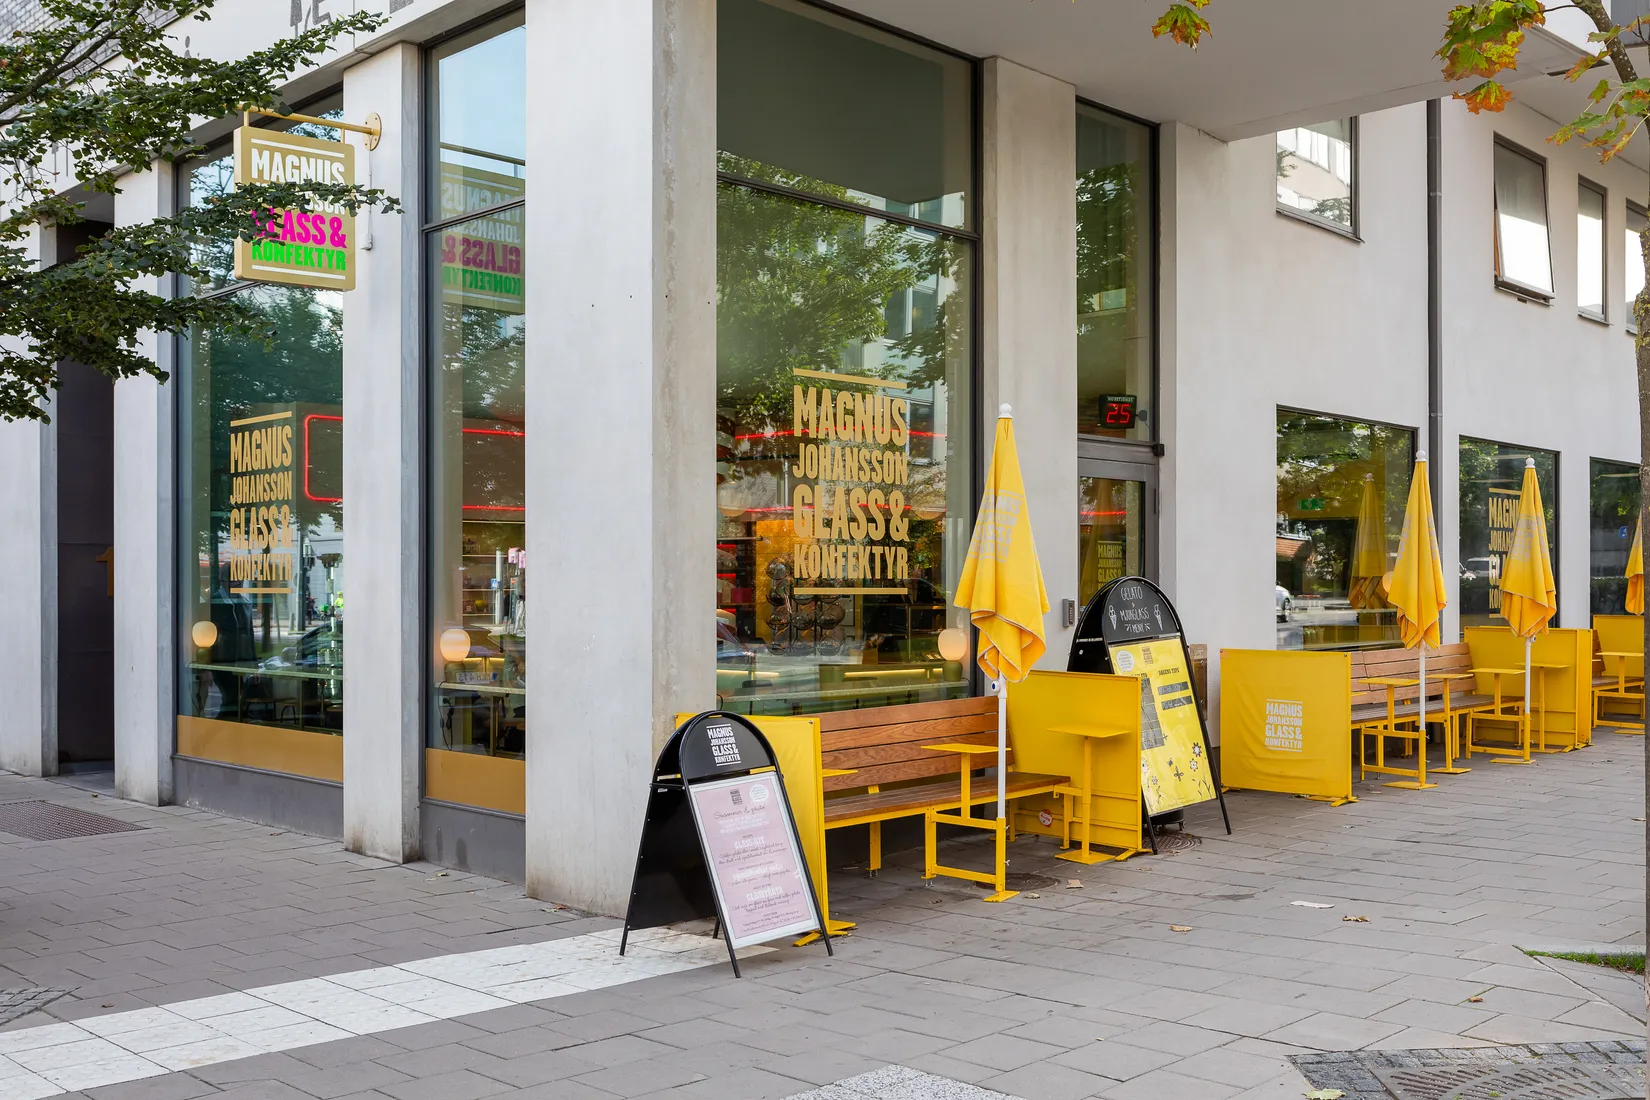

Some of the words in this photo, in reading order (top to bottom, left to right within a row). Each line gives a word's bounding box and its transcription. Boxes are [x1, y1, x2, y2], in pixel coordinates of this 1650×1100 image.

[251, 148, 345, 187] MAGNUS
[251, 207, 327, 246] LASS
[329, 216, 348, 249] &
[251, 239, 347, 271] KONFEKTYR
[794, 385, 907, 447] MAGNUS
[1106, 403, 1131, 424] 25
[230, 425, 293, 473] MAGNUS
[792, 442, 908, 485] JOHANSSON
[230, 471, 293, 505] JOHANSSON
[230, 506, 279, 550] GLASS
[280, 504, 293, 548] &
[793, 483, 885, 541] GLASS
[889, 490, 910, 542] &
[1488, 497, 1520, 528] MAGN
[1098, 544, 1122, 558] MAGNUS
[1488, 530, 1514, 552] JOHAN
[230, 552, 292, 581] KONFEKTYR
[793, 543, 909, 580] KONFEKTYR
[1120, 586, 1143, 601] GELATO
[1265, 702, 1302, 717] MAGNUS
[1265, 715, 1303, 727] JOHANSSON
[706, 726, 734, 739] MAGNUS
[1264, 737, 1303, 749] KONFEKTYR
[1265, 724, 1295, 739] GLASS
[1295, 727, 1303, 741] &
[711, 744, 734, 756] GLASS
[731, 743, 740, 754] &
